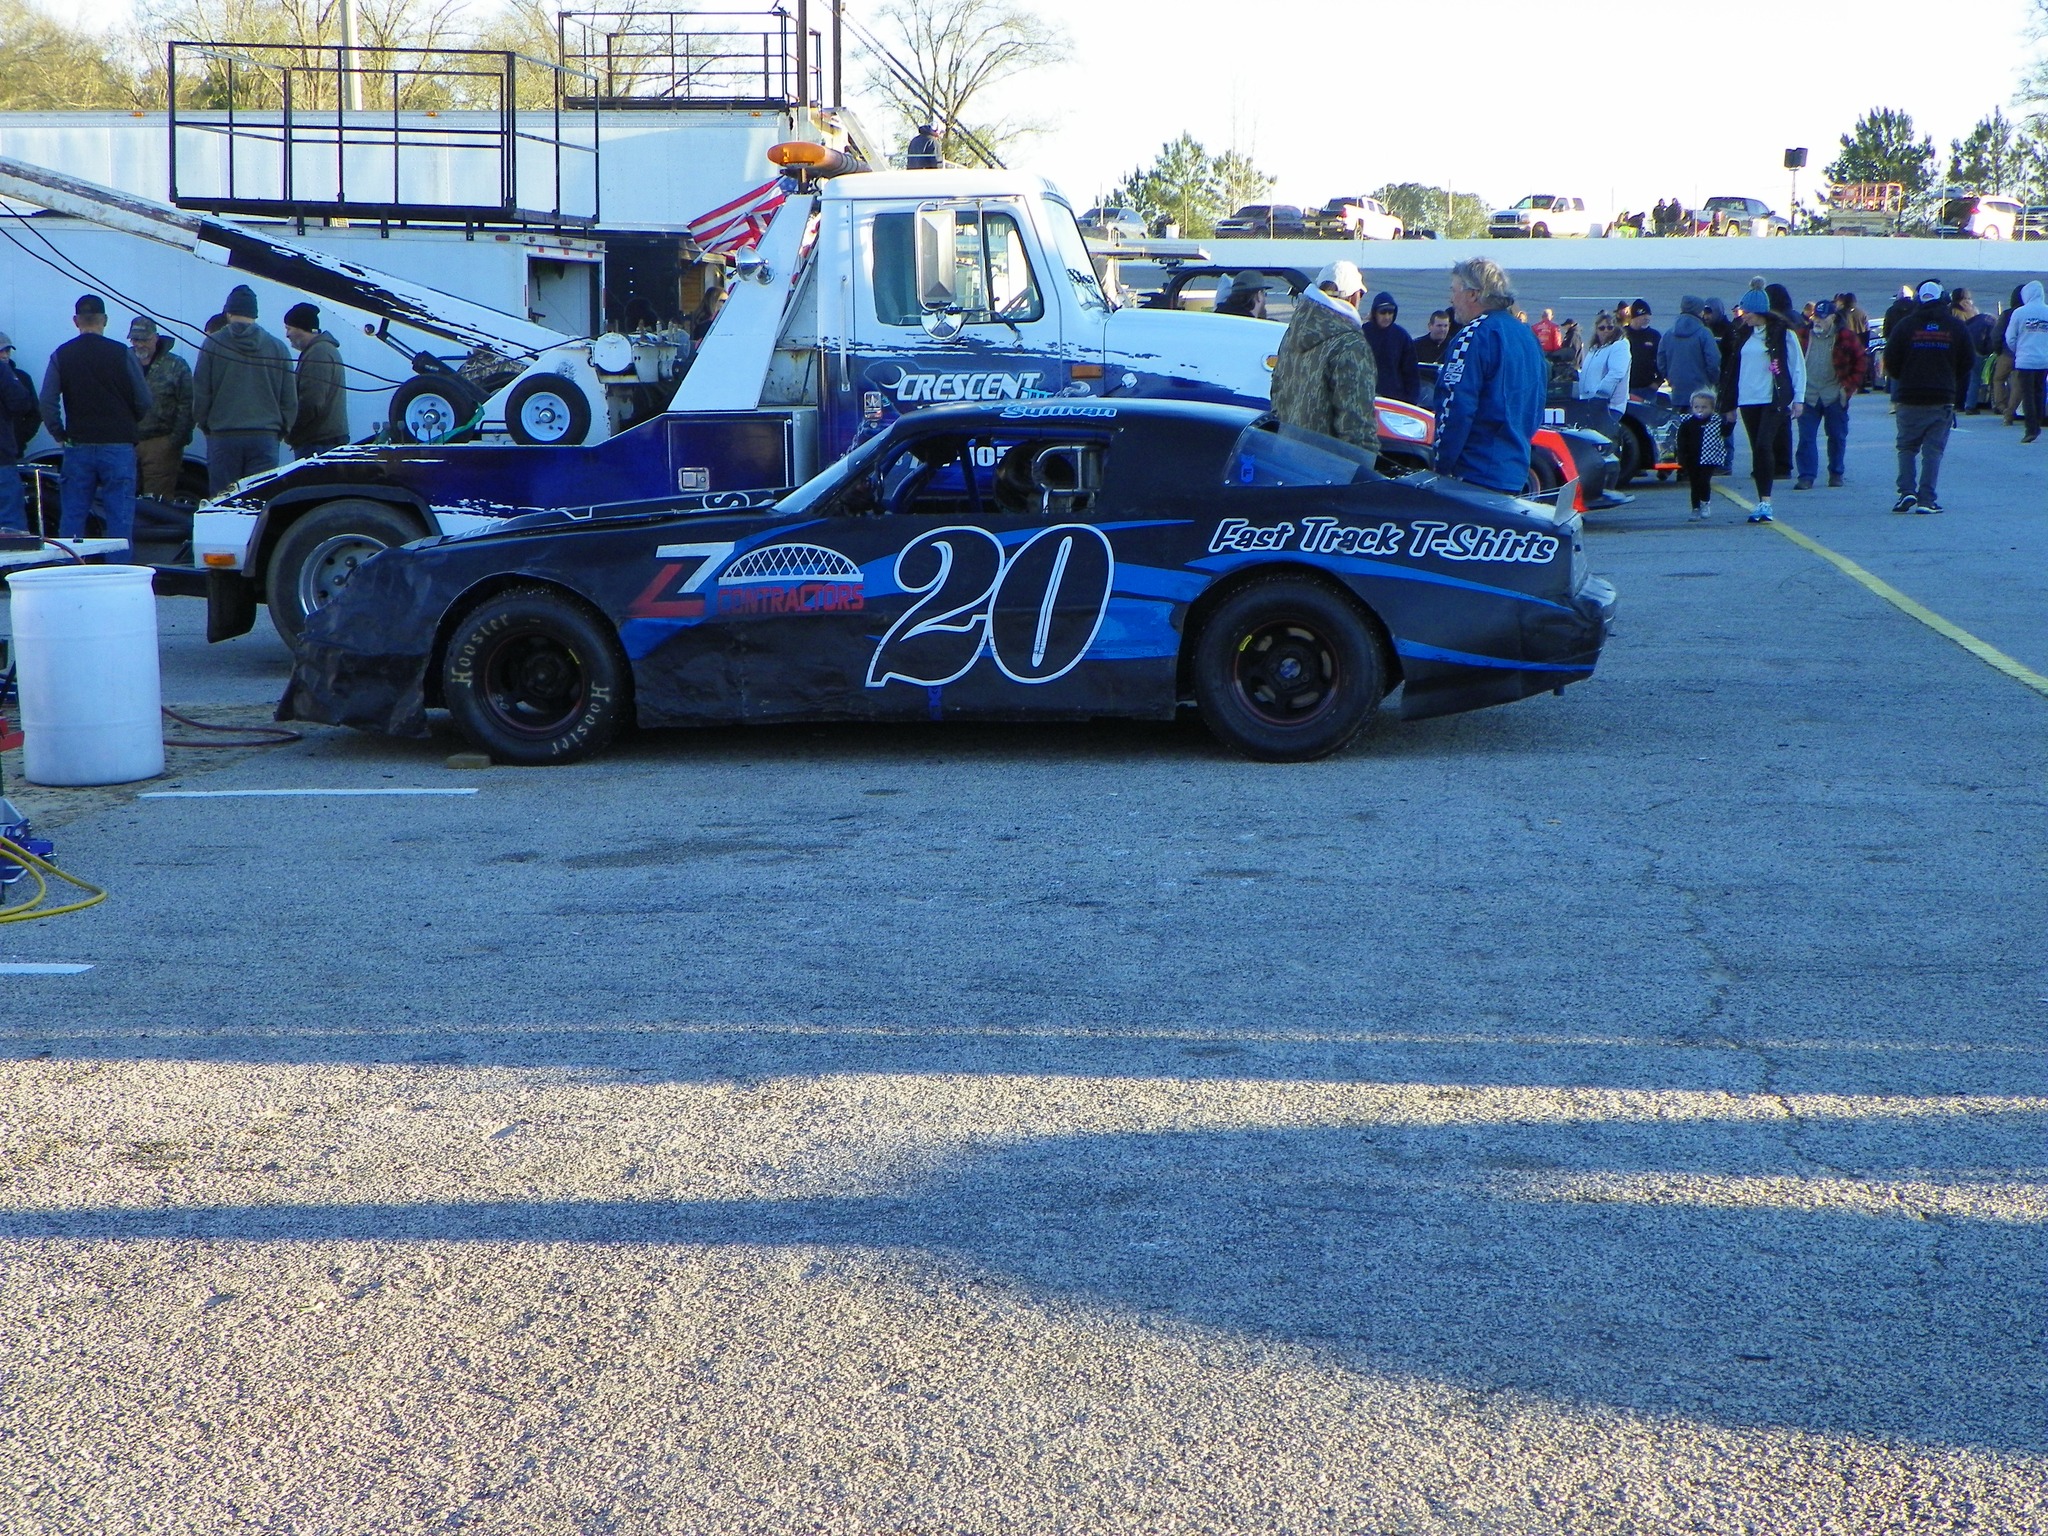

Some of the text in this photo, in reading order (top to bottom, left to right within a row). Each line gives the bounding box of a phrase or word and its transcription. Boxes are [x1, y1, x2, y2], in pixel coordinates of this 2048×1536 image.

[896, 372, 1041, 400] CRESCENT
[1208, 516, 1559, 564] Fast Track T-Shirts
[717, 584, 864, 614] CONTRACTORS
[865, 523, 1114, 687] 20
[450, 613, 508, 688] Hoosier
[551, 681, 611, 755] Hoosier
